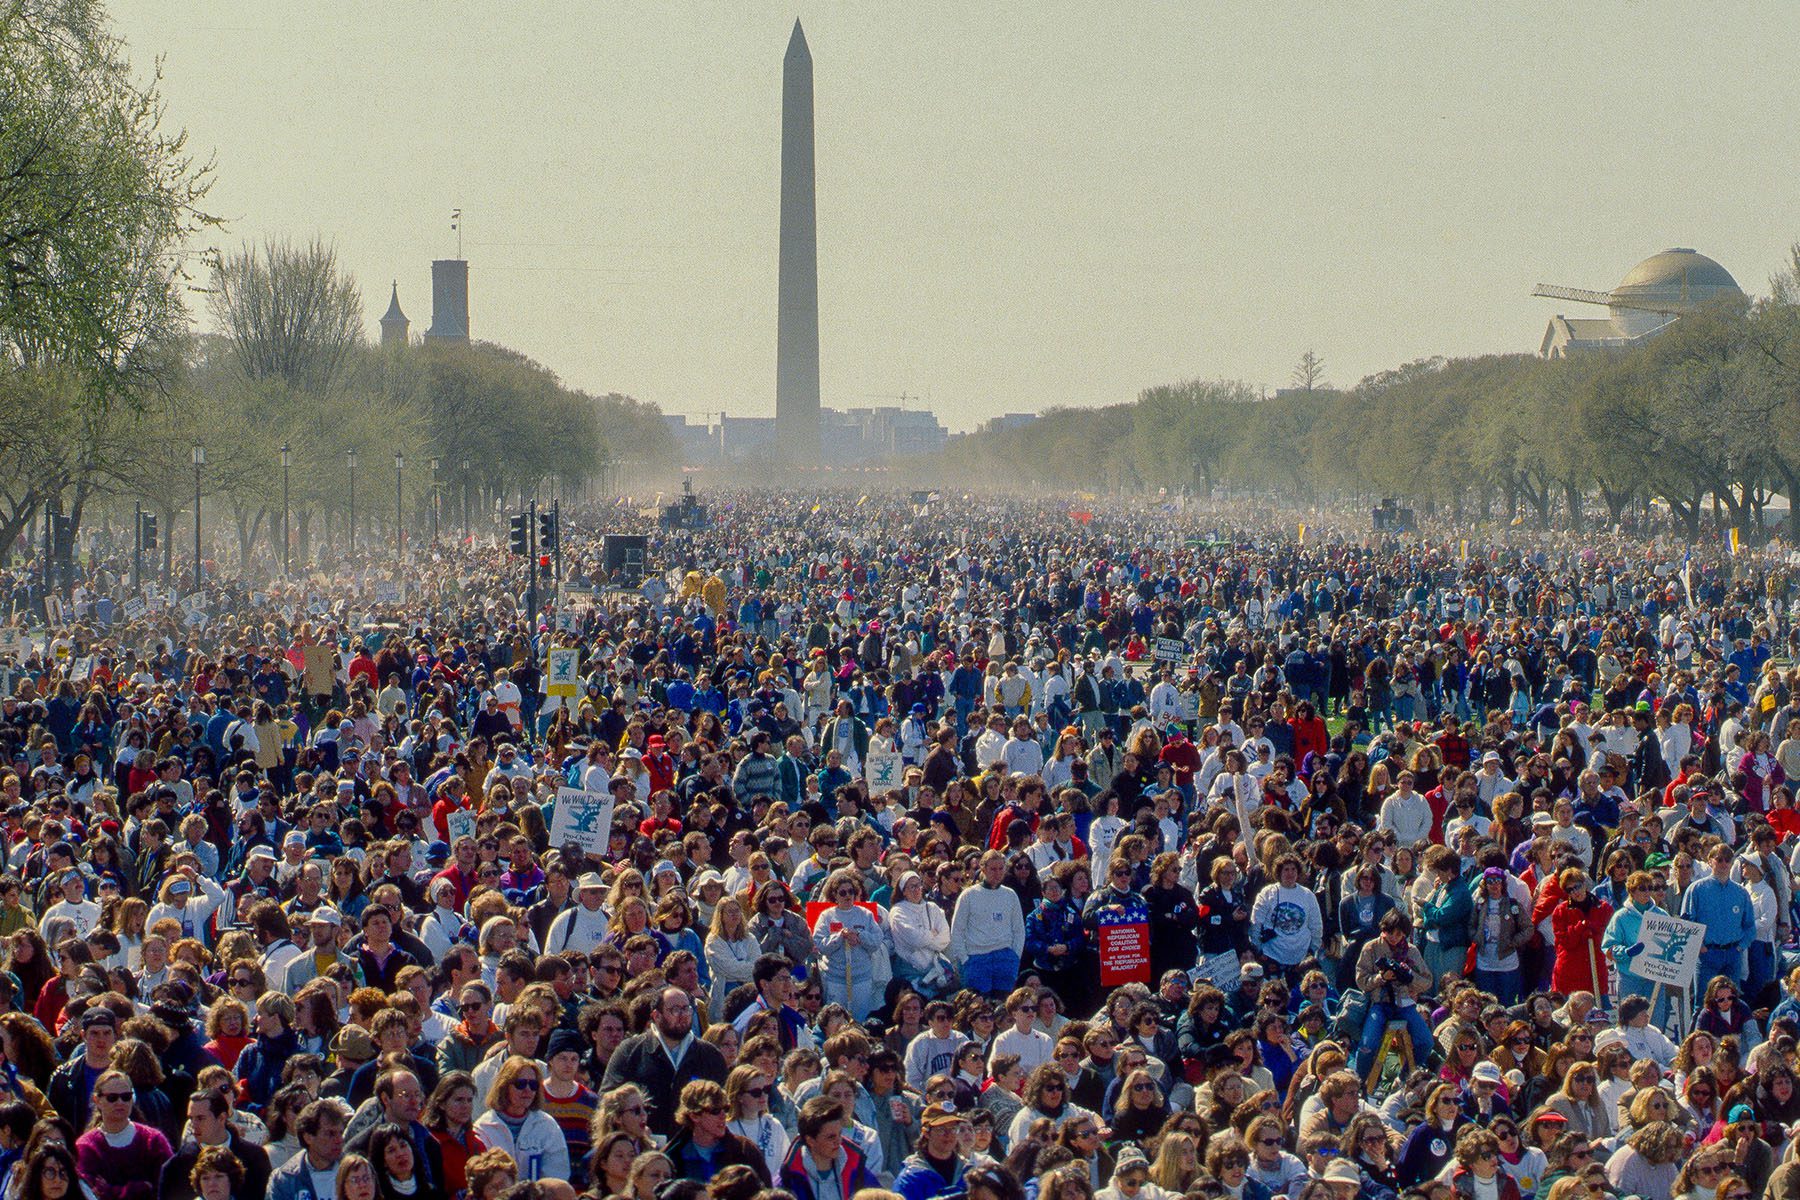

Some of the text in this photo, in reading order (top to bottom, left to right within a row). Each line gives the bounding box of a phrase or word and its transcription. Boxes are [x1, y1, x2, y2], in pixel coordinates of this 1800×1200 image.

[562, 794, 610, 806] We Will Decide
[563, 832, 595, 842] Pro-Choice
[1646, 920, 1657, 932] We
[1657, 920, 1674, 932] Will
[1674, 922, 1700, 936] Decide
[1643, 959, 1681, 974] Pro-Choice
[1644, 967, 1676, 980] President
